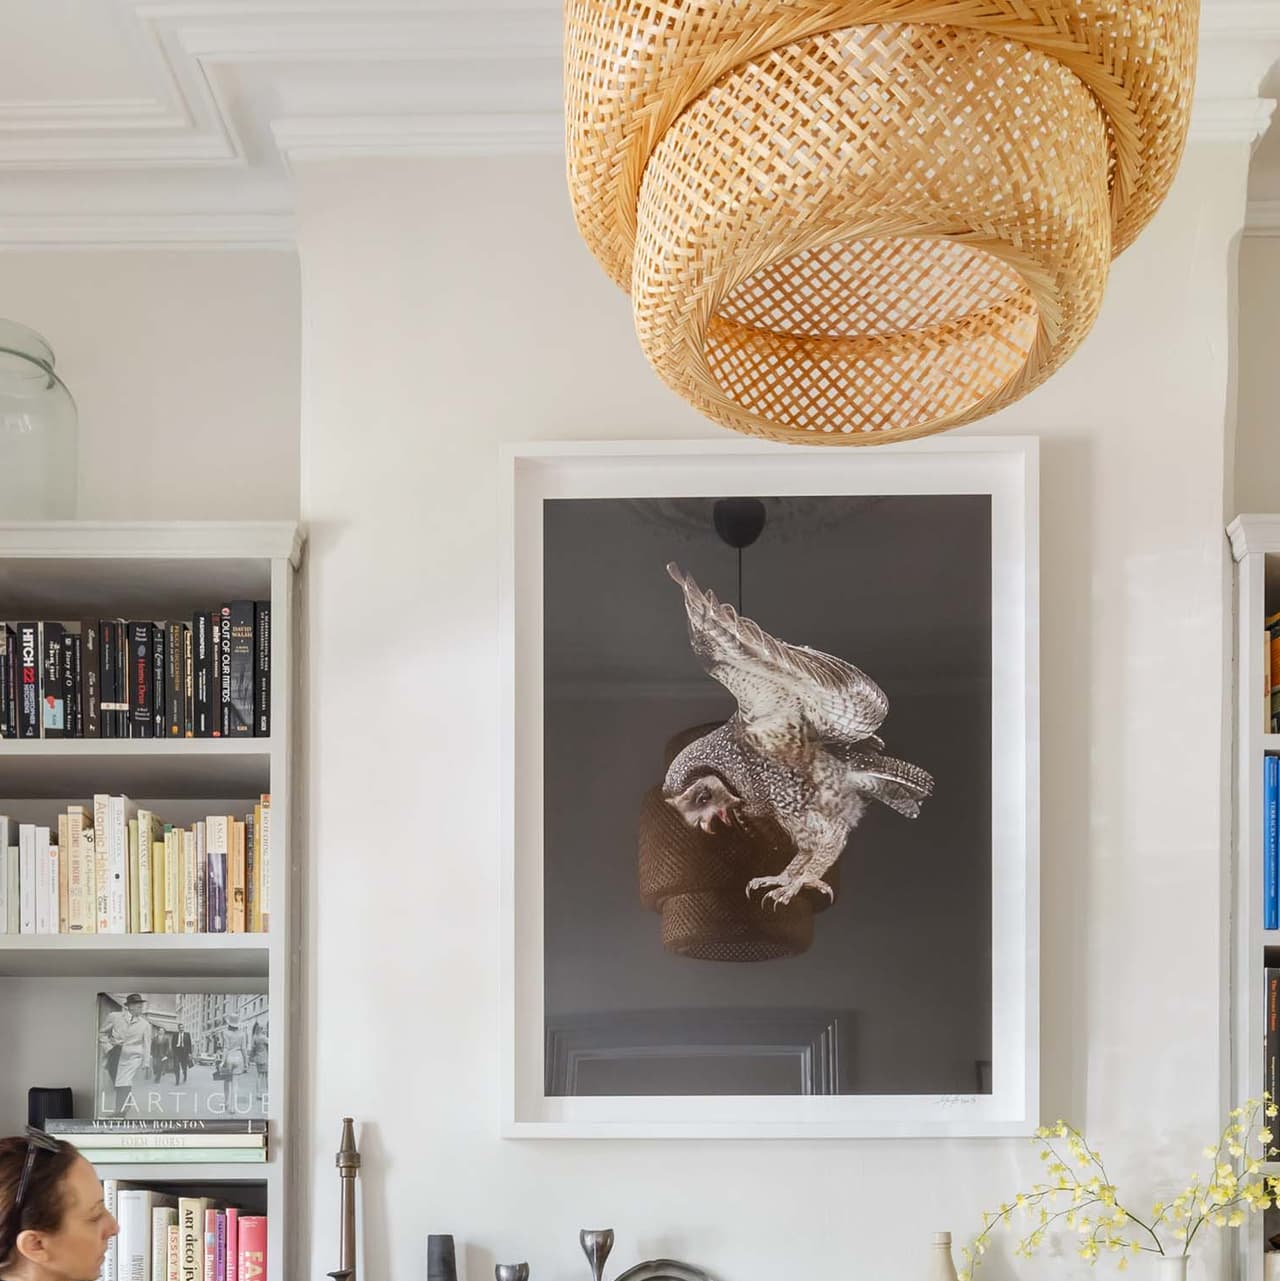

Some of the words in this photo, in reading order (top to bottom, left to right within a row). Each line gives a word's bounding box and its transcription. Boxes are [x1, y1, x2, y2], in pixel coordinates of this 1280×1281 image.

[221, 620, 231, 639] OUT
[22, 628, 35, 667] HITCH
[221, 640, 231, 652] OF
[64, 651, 74, 669] Story
[222, 654, 231, 674] OUR
[22, 668, 35, 683] 22
[138, 659, 148, 683] Homo
[184, 1208, 195, 1230] ART
[169, 1231, 178, 1267] ISSEY
